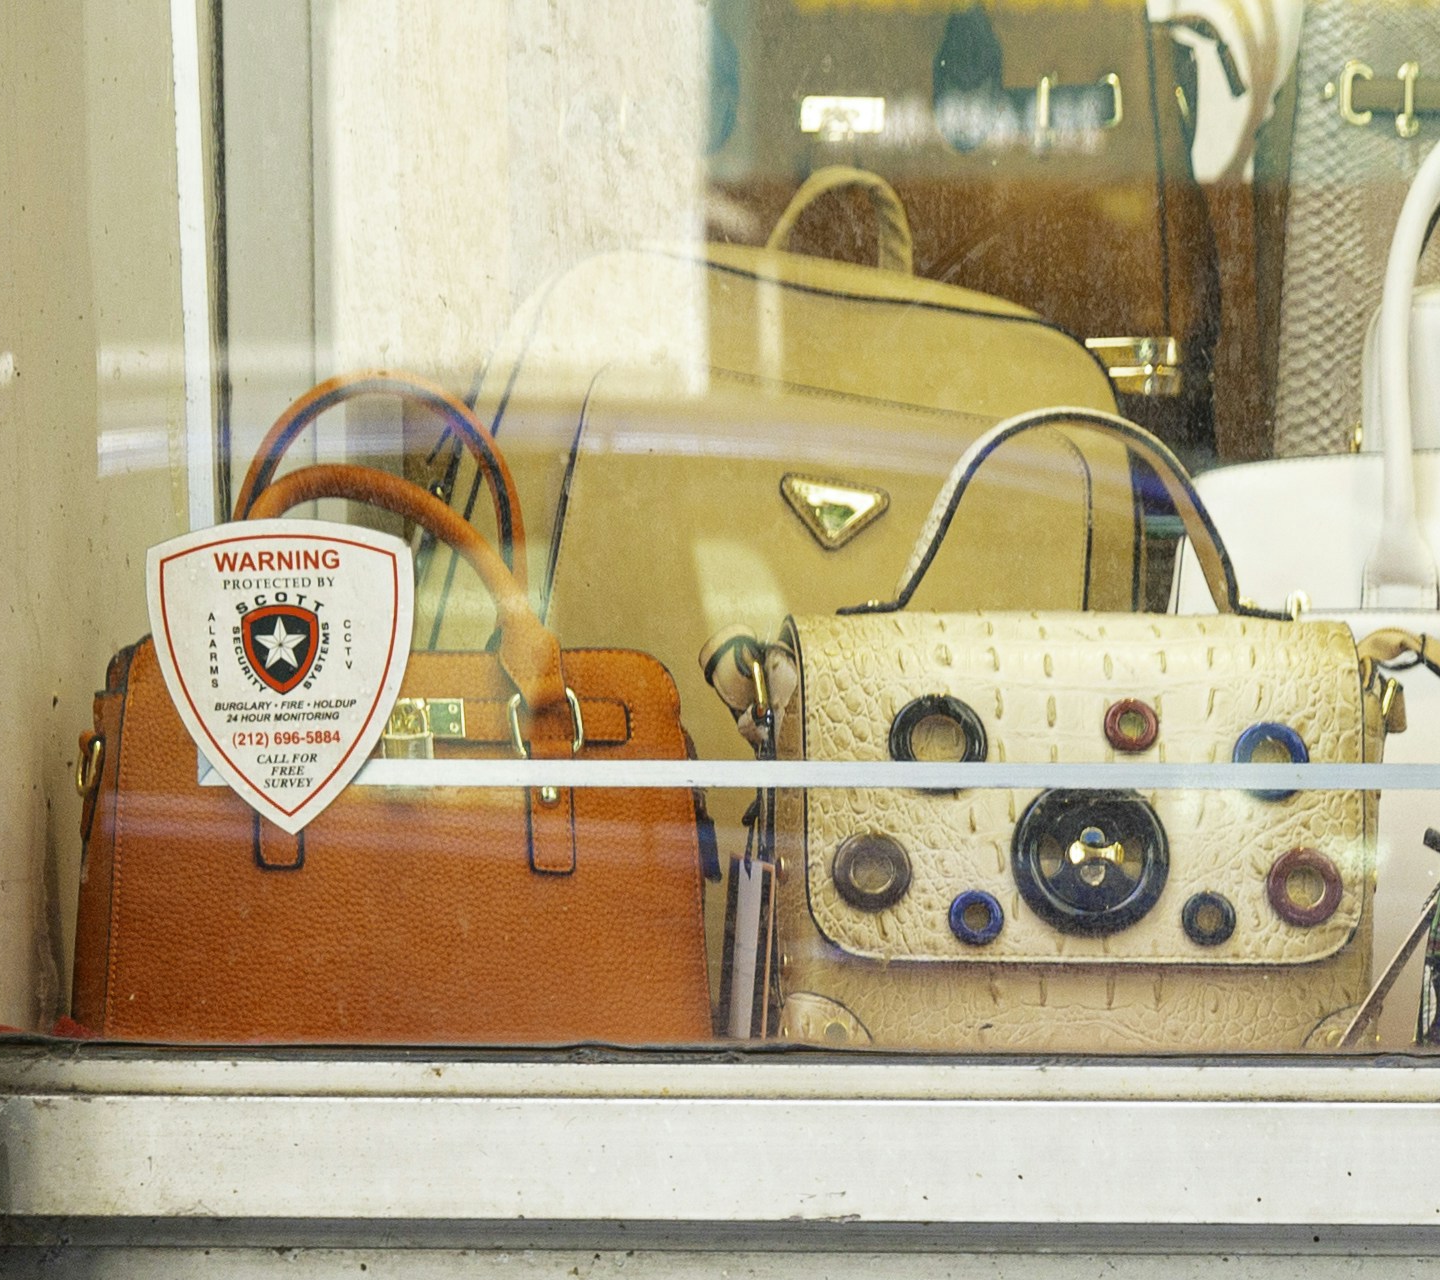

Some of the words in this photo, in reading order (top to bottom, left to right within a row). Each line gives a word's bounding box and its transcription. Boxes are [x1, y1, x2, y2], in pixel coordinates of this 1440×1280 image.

[214, 549, 340, 572] WARNING
[223, 577, 311, 590] PROTECTED
[317, 576, 335, 587] BY
[235, 592, 325, 615] SCOTT
[207, 612, 219, 688] ALARMS
[343, 619, 353, 670] CCTV
[233, 626, 267, 692] SECURITY
[303, 622, 330, 690] SYSTEMS
[214, 701, 272, 711] BURGLARY
[281, 700, 305, 710] FIRE
[313, 699, 357, 708] HOLDUP
[226, 714, 239, 723] 24
[240, 713, 271, 723] HOUR
[273, 711, 340, 722] MONITORING
[232, 732, 269, 747] (212)
[273, 731, 341, 745] 696-5884
[257, 754, 289, 764] CALL
[292, 753, 318, 764] FOR
[271, 765, 305, 776] FREE
[264, 777, 314, 788] SURVEY
